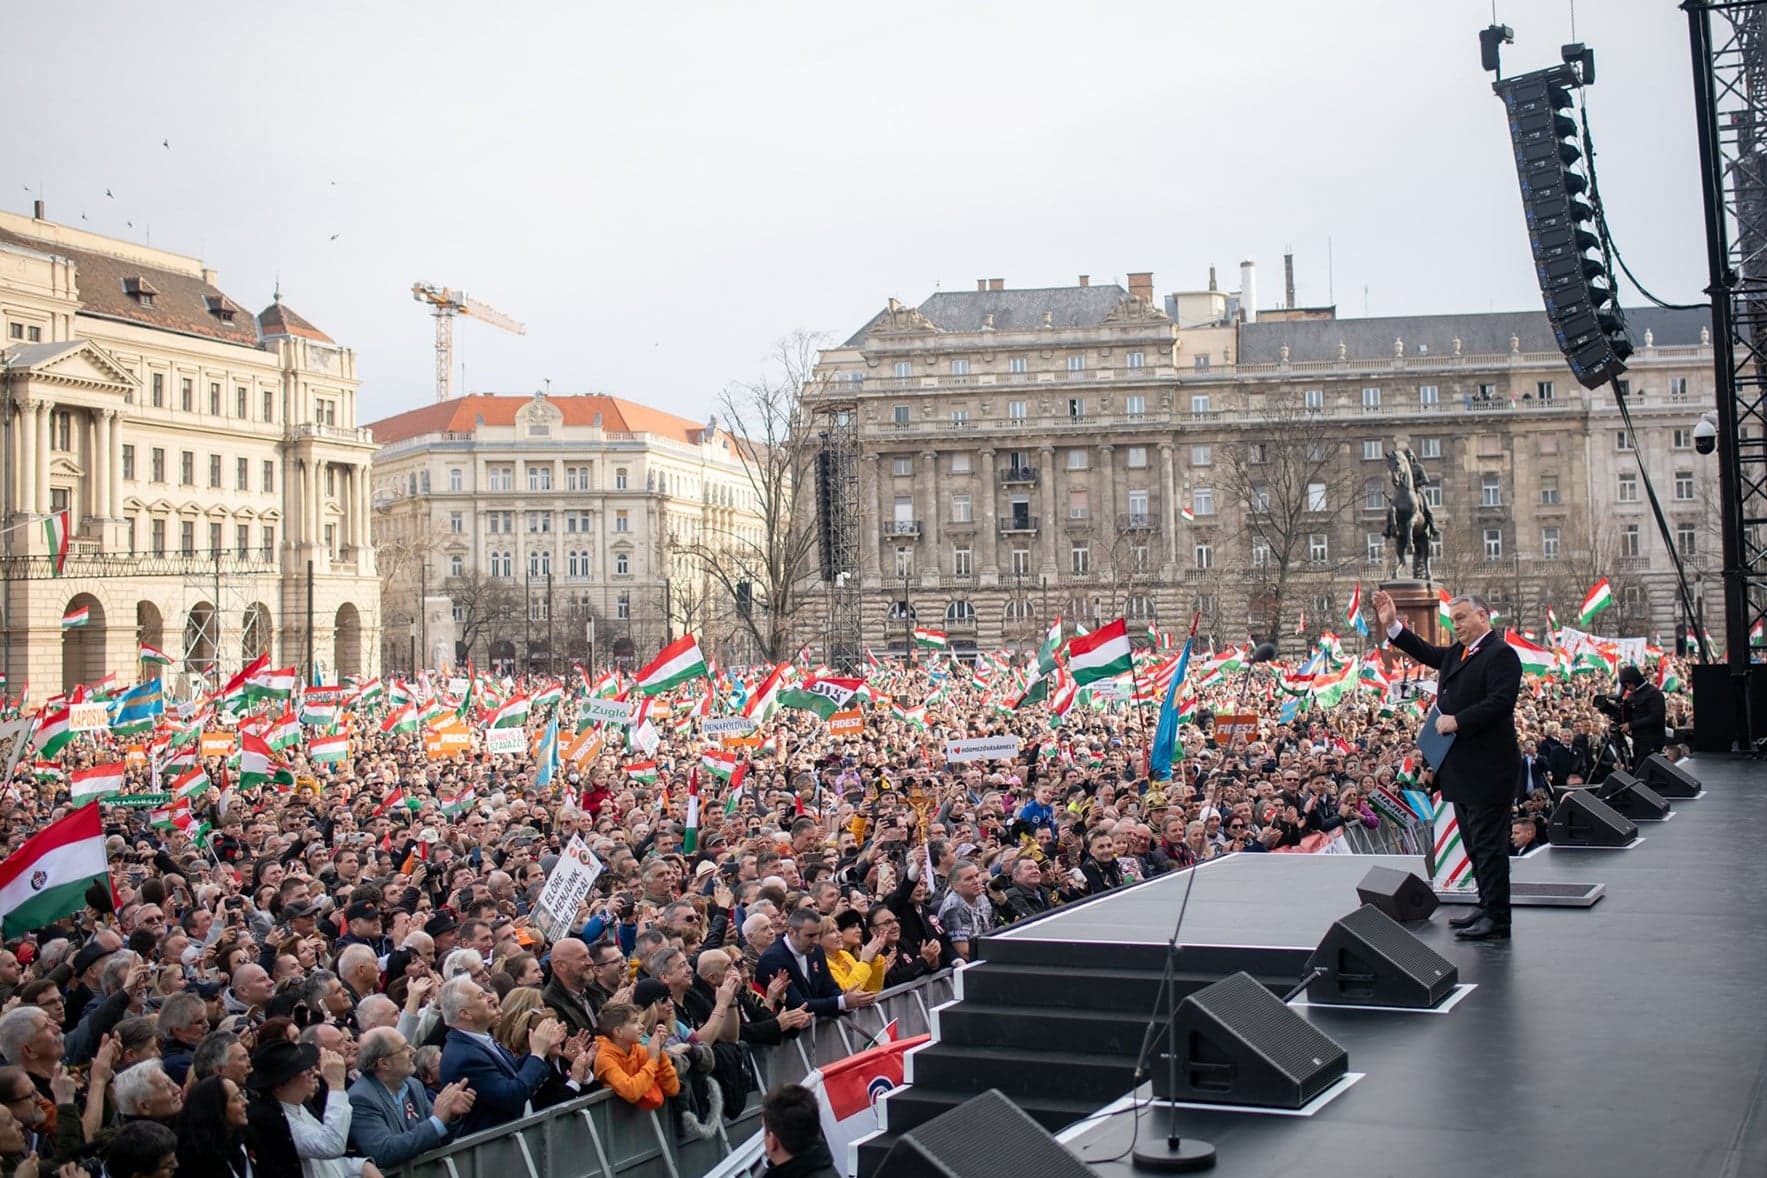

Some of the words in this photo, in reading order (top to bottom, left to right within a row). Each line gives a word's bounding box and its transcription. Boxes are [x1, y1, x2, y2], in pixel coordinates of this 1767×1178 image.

[591, 705, 627, 720] Zugló
[831, 719, 861, 728] FIDESZ
[544, 872, 565, 906] ELŐRE
[552, 868, 583, 918] MENJÜNK.
[561, 911, 573, 928] NE
[568, 877, 590, 916] HÁTRA!
